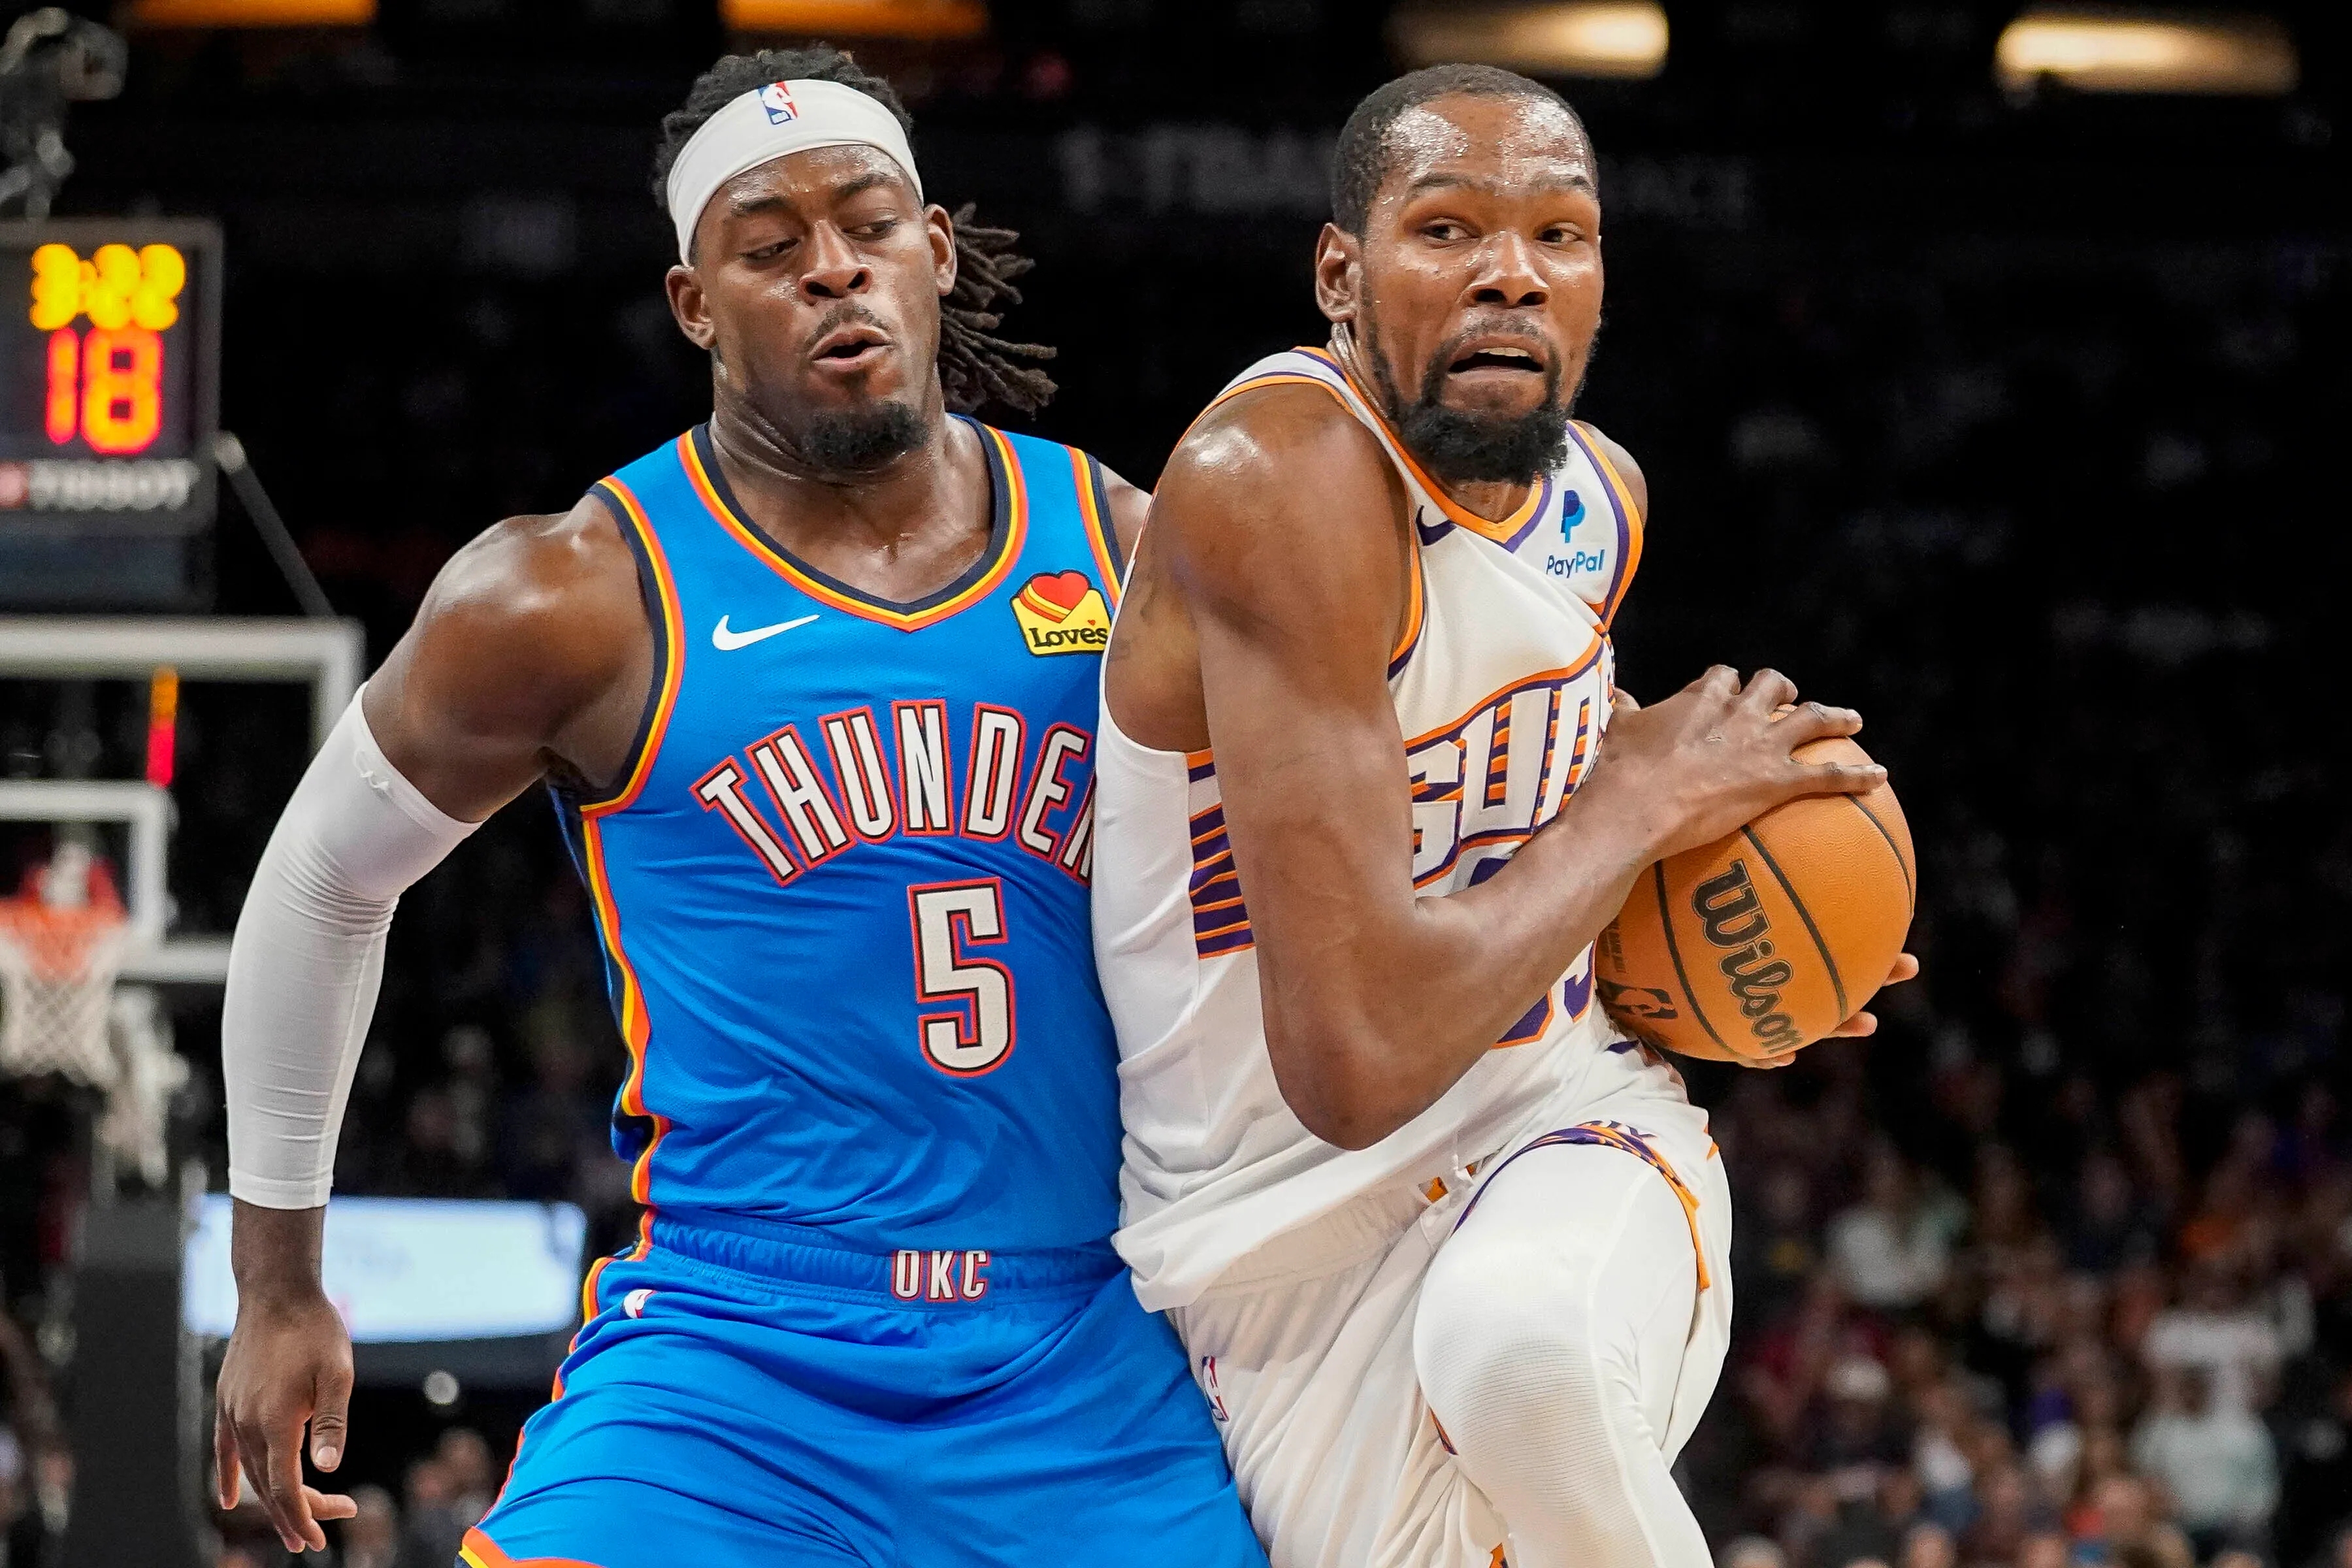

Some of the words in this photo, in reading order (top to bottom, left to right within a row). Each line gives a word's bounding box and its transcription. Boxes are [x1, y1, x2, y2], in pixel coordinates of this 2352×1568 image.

[46, 326, 163, 455] 18
[1546, 549, 1605, 578] PayPal
[1406, 653, 1614, 883] SUN
[907, 877, 1017, 1078] 5
[1691, 858, 1804, 1054] Wilson
[890, 1249, 990, 1301] OKC
